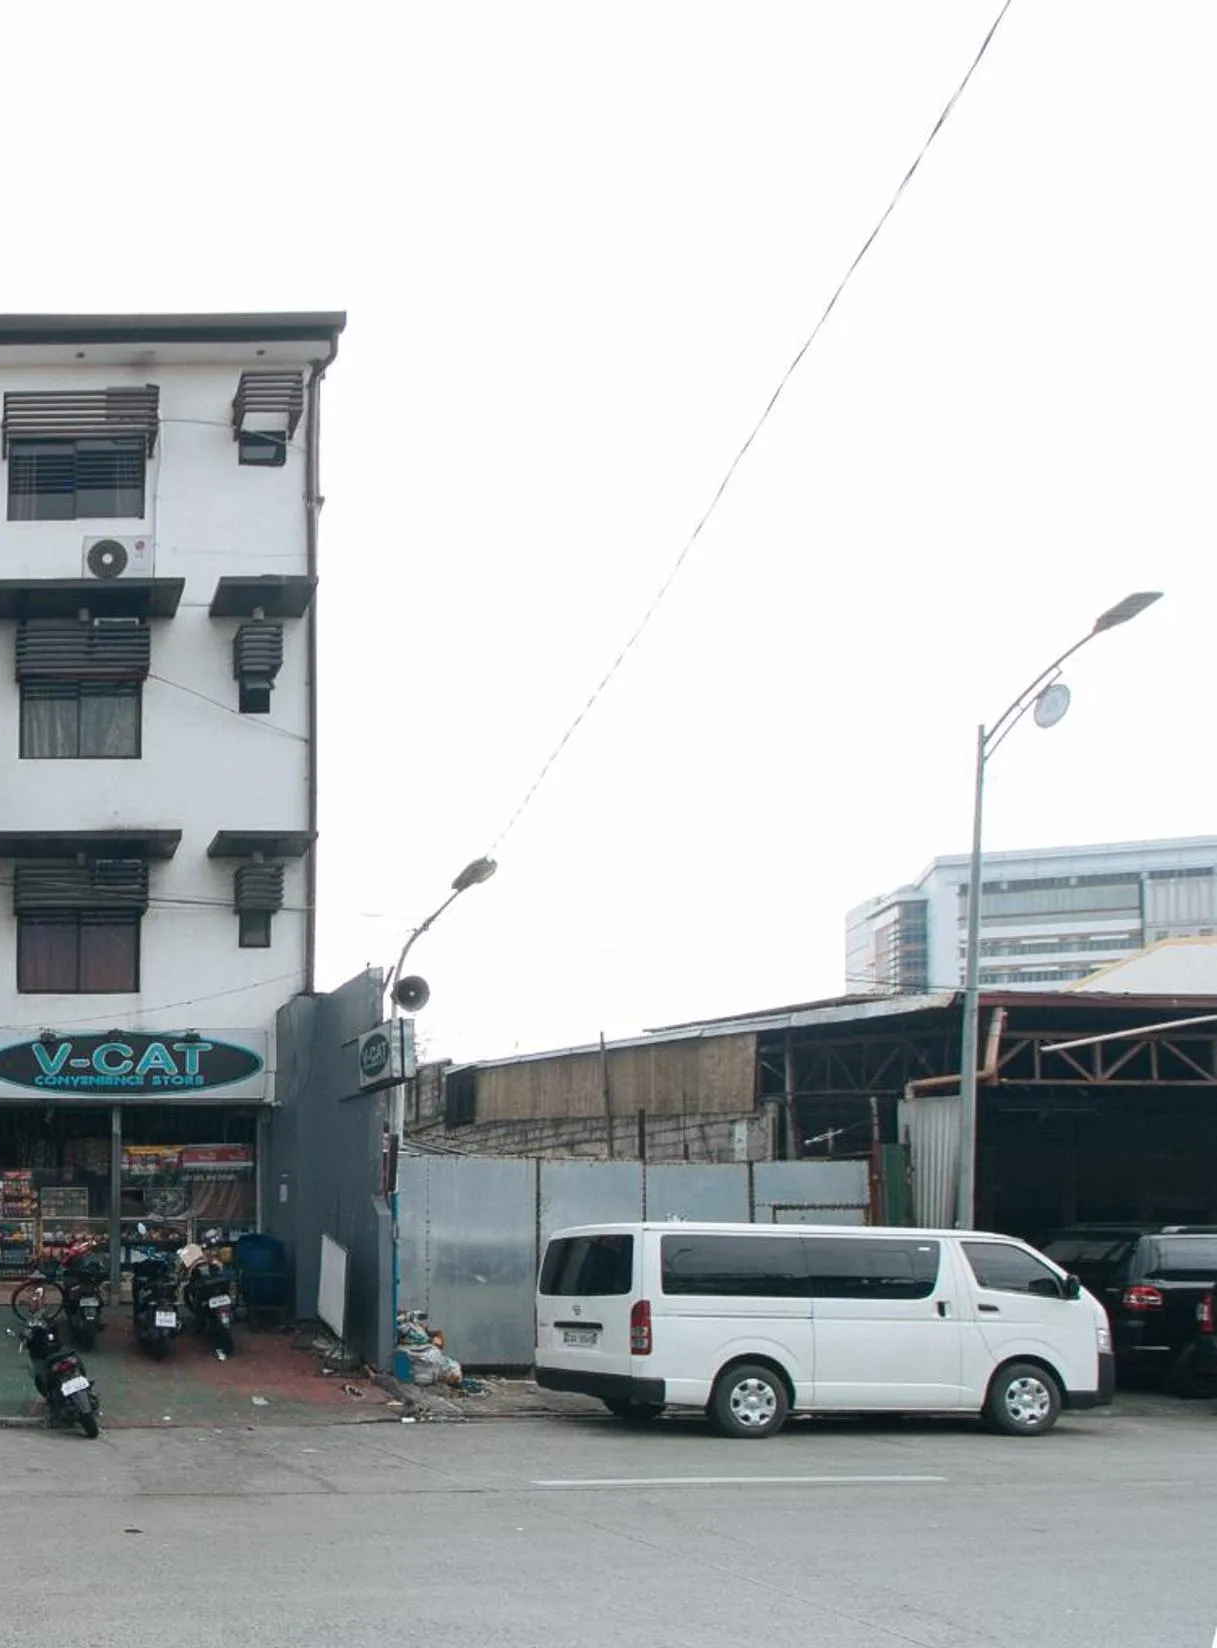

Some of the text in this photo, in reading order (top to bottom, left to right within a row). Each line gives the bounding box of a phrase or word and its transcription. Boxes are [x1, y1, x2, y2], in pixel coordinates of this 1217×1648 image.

[32, 1041, 213, 1076] V-CAT
[34, 1074, 205, 1087] CONVENIENCE STORE
